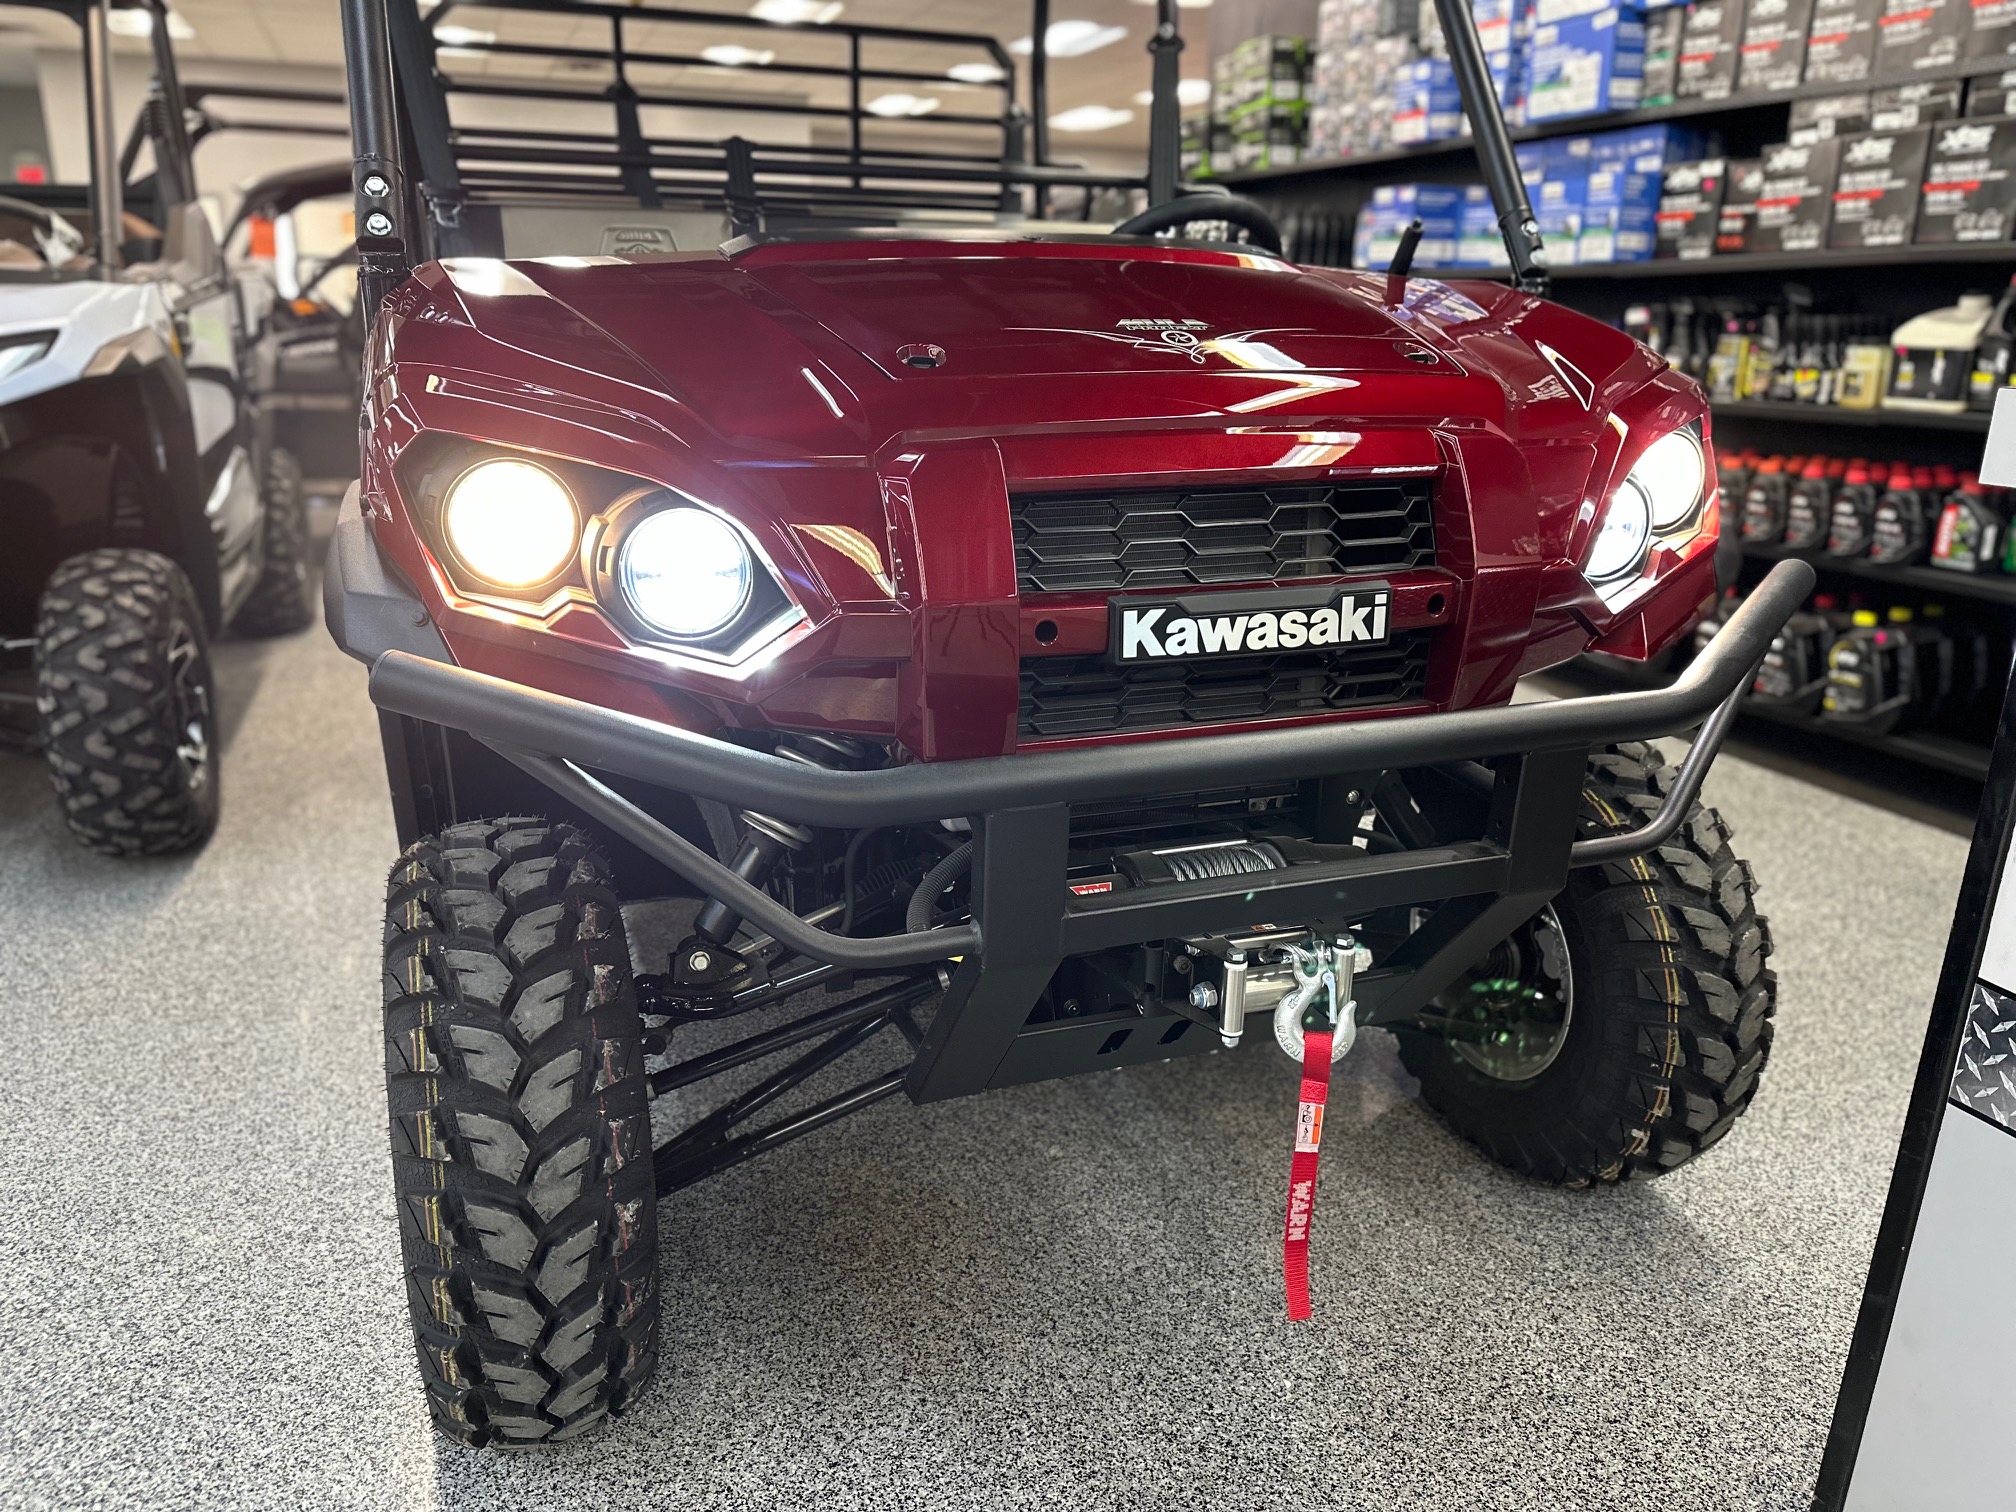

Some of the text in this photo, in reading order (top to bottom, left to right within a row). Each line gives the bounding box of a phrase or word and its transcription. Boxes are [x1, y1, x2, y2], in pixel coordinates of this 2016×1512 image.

[1122, 593, 1388, 659] Kawasaki
[1276, 1024, 1301, 1058] WARN
[1288, 1180, 1312, 1241] WARN
